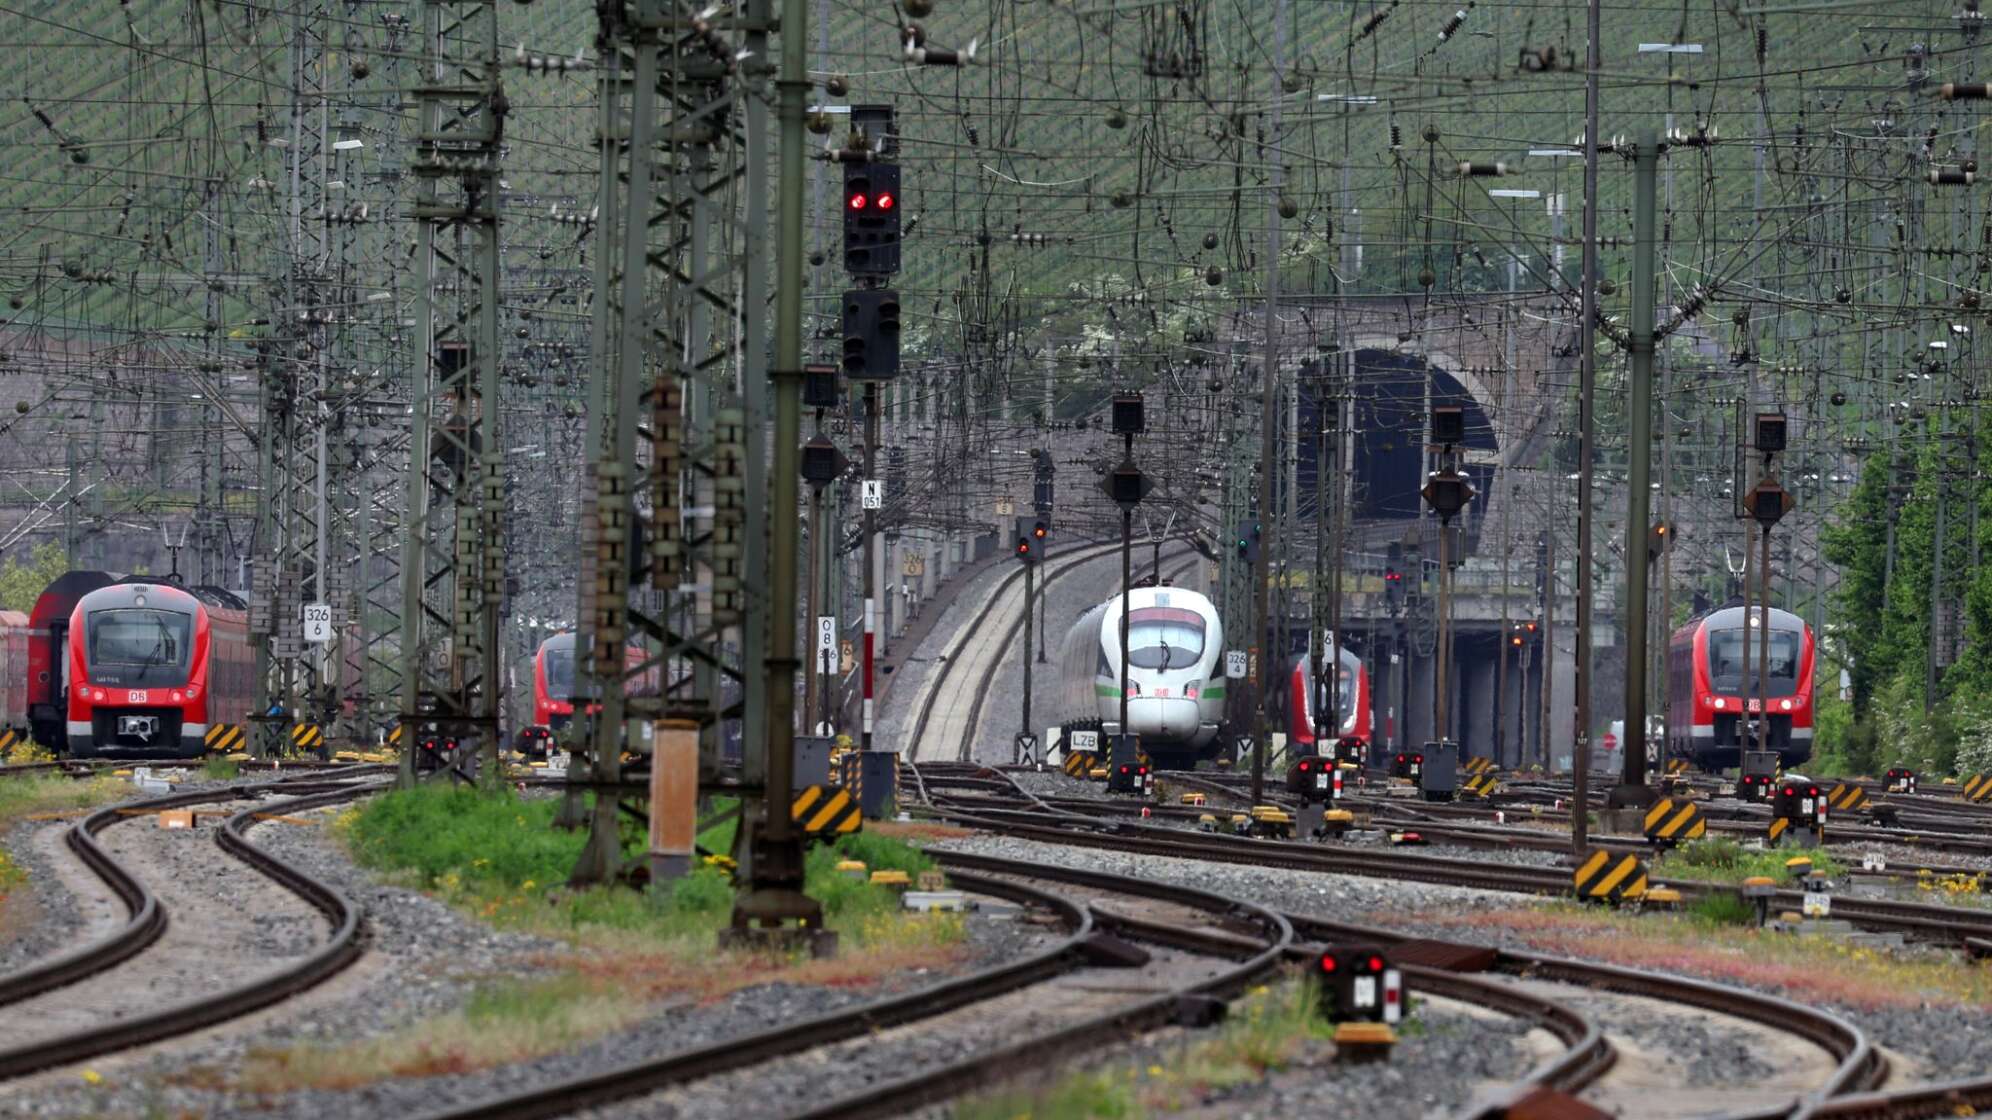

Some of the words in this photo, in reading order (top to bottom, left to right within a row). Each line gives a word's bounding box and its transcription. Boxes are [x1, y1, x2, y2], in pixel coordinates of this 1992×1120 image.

[868, 483, 875, 496] N
[864, 497, 880, 507] 051
[307, 608, 329, 621] 326
[314, 624, 322, 635] 6
[822, 619, 831, 631] 0
[823, 633, 831, 644] 8
[818, 649, 837, 659] 36
[130, 692, 145, 702] DB
[1072, 734, 1096, 747] LZB
